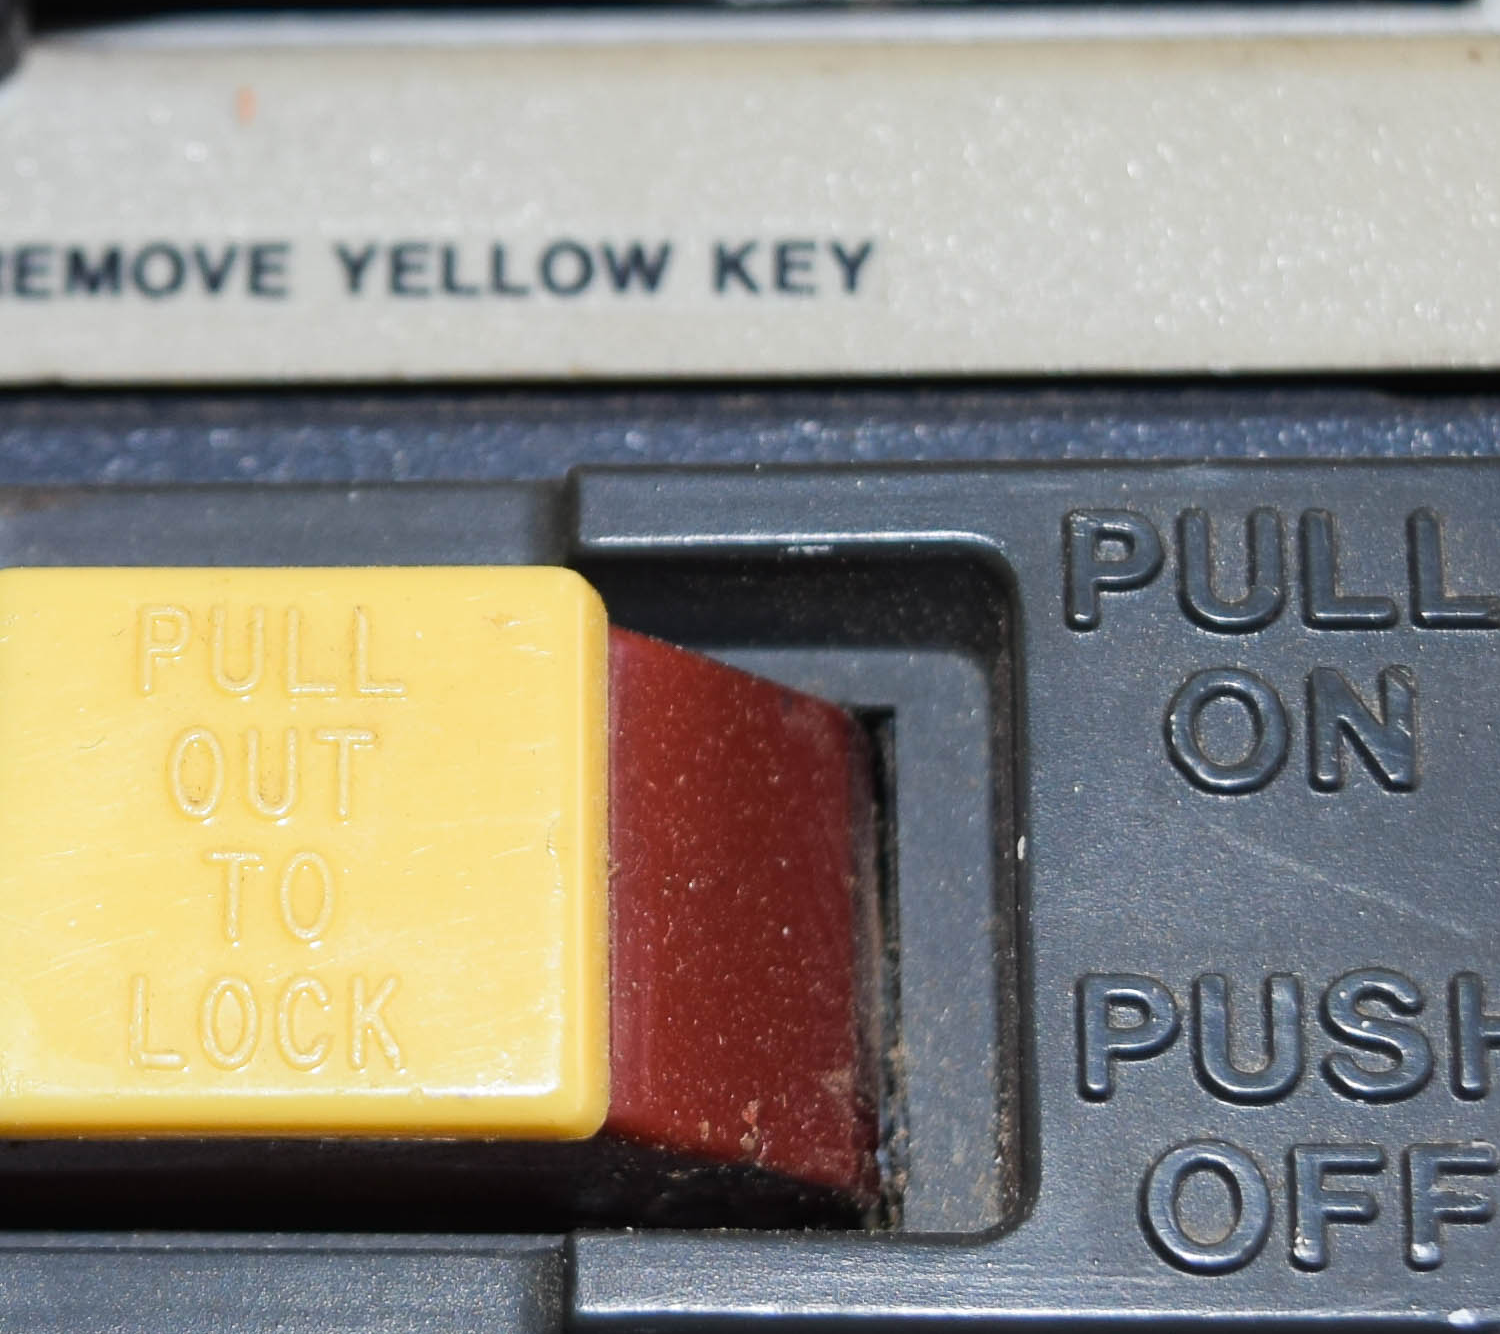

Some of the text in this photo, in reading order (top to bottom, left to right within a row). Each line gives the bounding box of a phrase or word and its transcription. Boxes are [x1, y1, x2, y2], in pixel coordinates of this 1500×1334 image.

[332, 240, 672, 299] YELLOW
[712, 237, 876, 297] KEY
[137, 603, 408, 699] PULL
[166, 726, 380, 823] OUT
[1163, 665, 1421, 795] ON
[202, 850, 336, 946] TO
[126, 974, 407, 1072] LOCK
[1139, 1139, 1500, 1275] OFF
